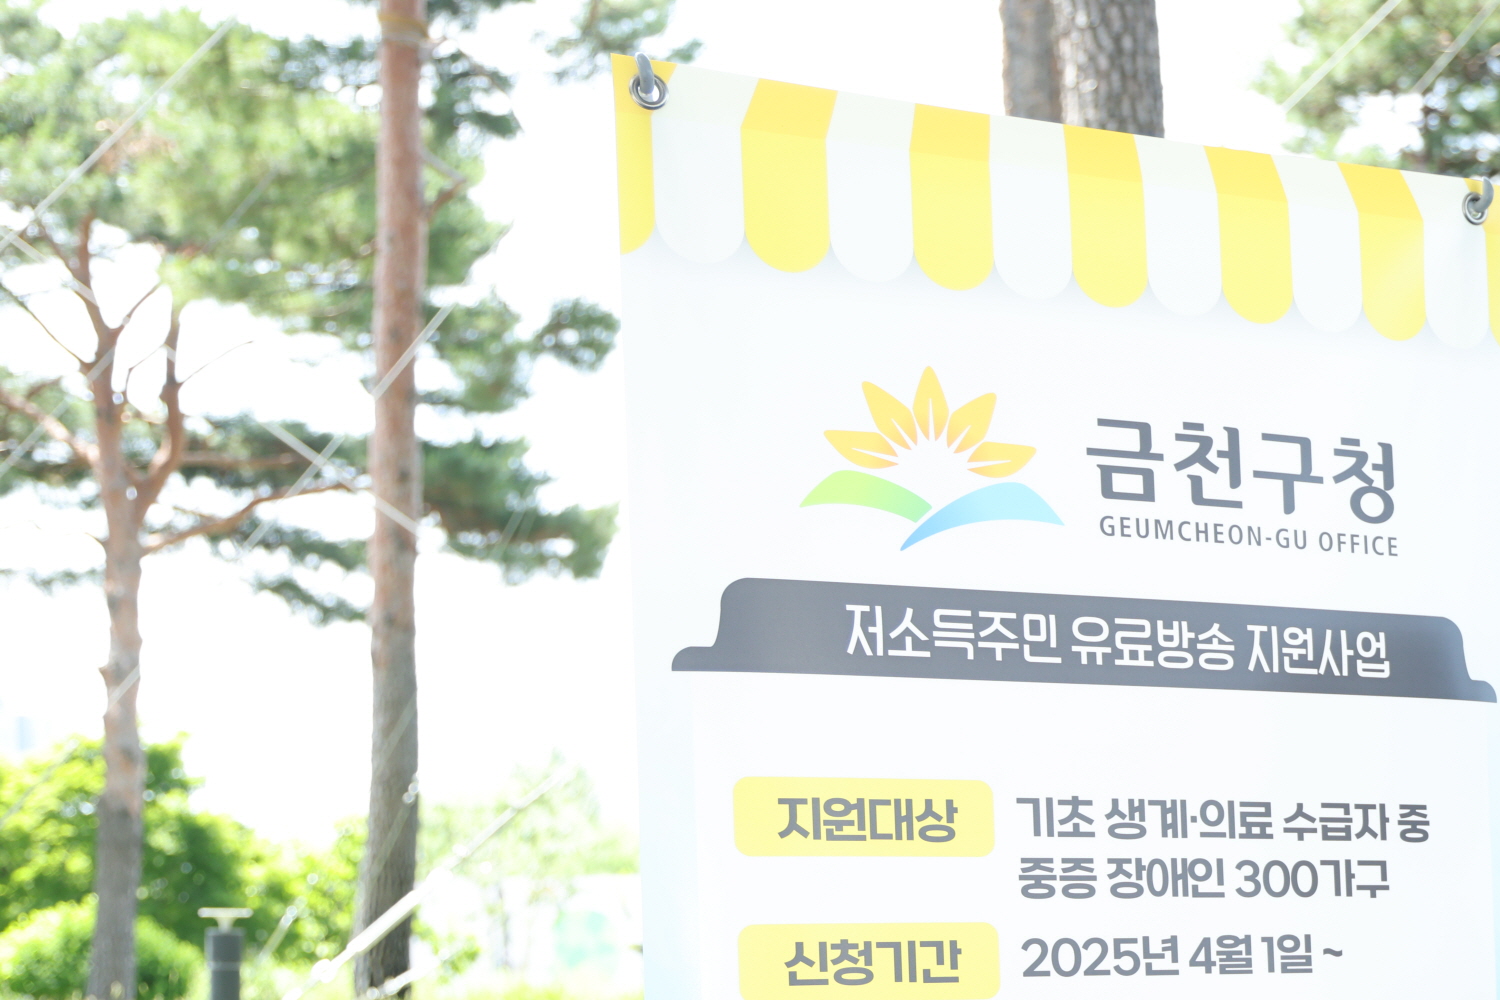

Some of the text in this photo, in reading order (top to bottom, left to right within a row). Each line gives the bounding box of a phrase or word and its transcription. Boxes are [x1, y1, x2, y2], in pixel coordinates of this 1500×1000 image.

[1086, 417, 1397, 525] 금천구청
[1098, 514, 1400, 557] GEUMCHEON-GU OFFICE
[844, 603, 1392, 679] 저소득주민 유료방송 지원사업
[777, 796, 958, 844] 지원대상
[1014, 797, 1430, 845] 기초 생계·의료 수급자 중
[1018, 856, 1391, 900] 중증 장애인 300가구
[784, 939, 962, 987] 신청기간
[1020, 935, 1179, 978] 2025년
[1188, 934, 1254, 976] 4월
[1260, 934, 1314, 975] 1일
